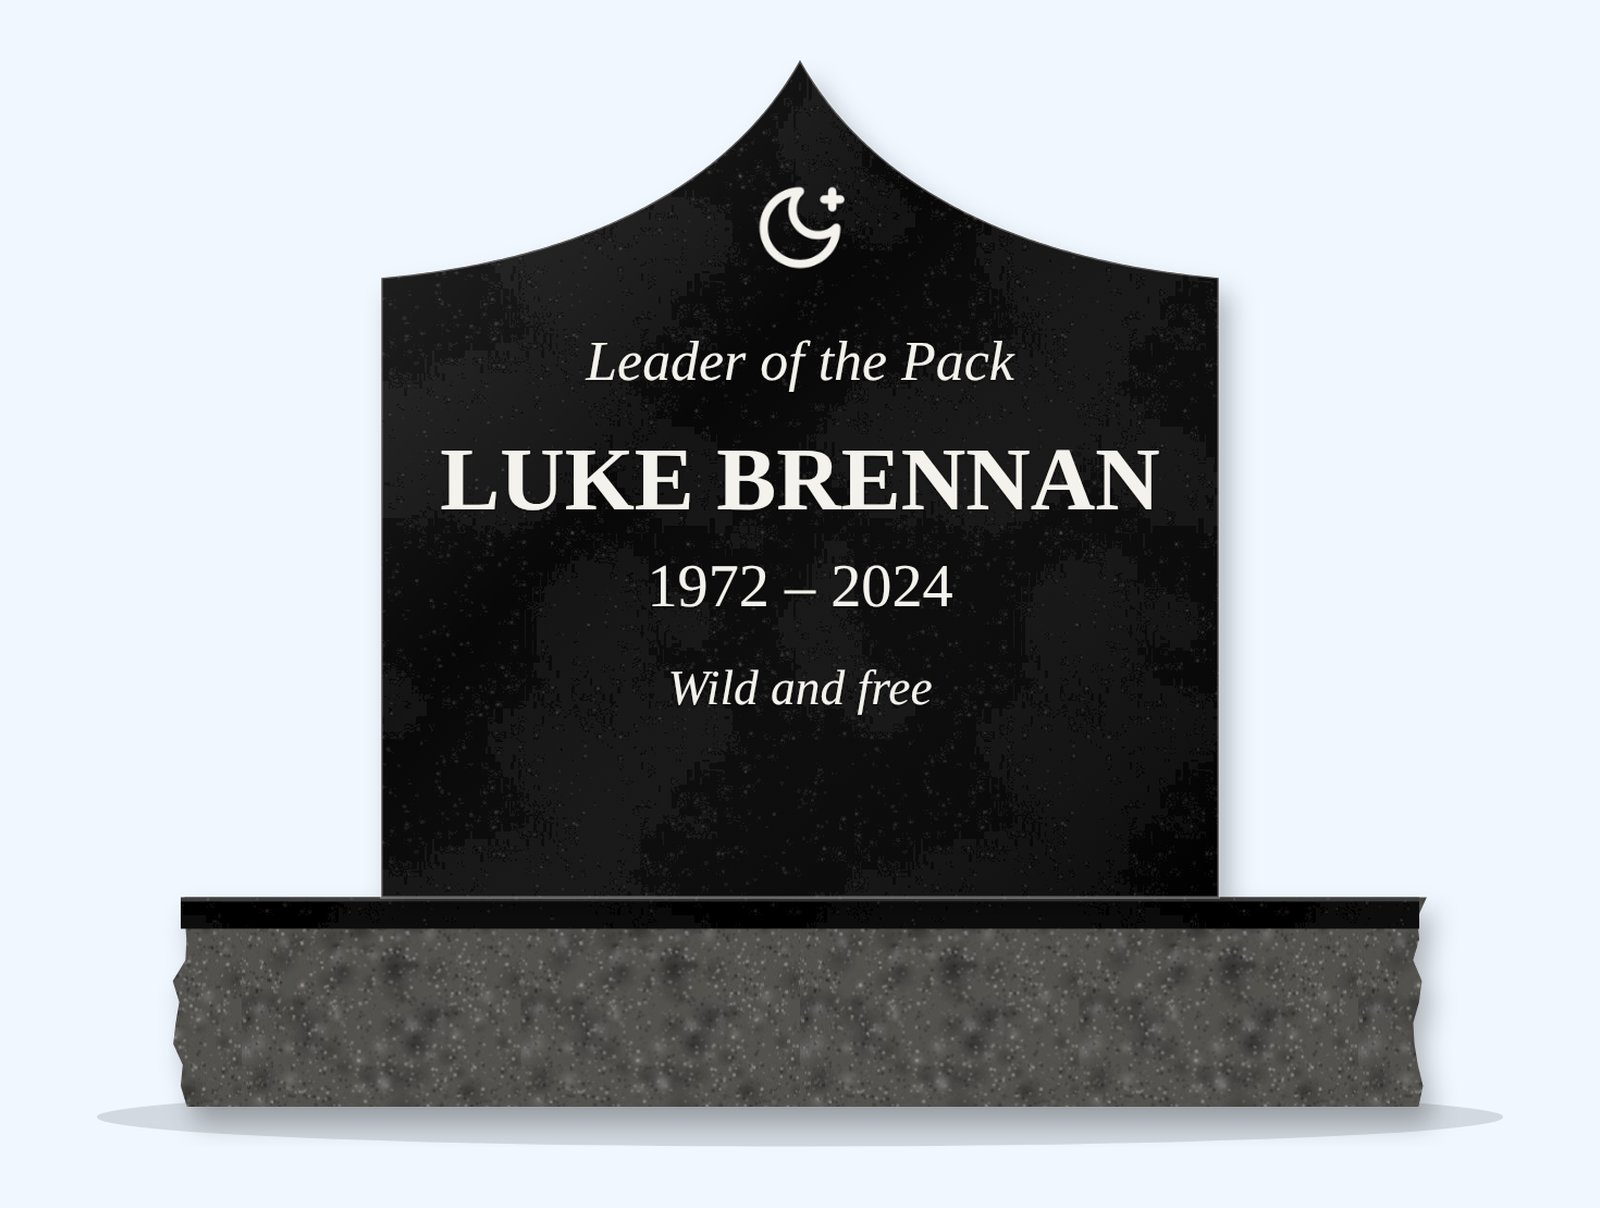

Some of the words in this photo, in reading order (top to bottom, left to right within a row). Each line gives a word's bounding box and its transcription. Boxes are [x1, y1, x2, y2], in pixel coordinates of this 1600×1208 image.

[585, 340, 747, 382] Leader
[761, 339, 812, 393] of
[820, 340, 887, 382] the
[900, 340, 1016, 382] Pack
[440, 449, 691, 511] LUKE
[717, 449, 1160, 511] BRENNAN
[651, 564, 767, 608] 1972
[832, 564, 953, 608] 2024
[670, 669, 760, 706] Wild
[771, 669, 846, 706] and
[857, 668, 933, 716] free
